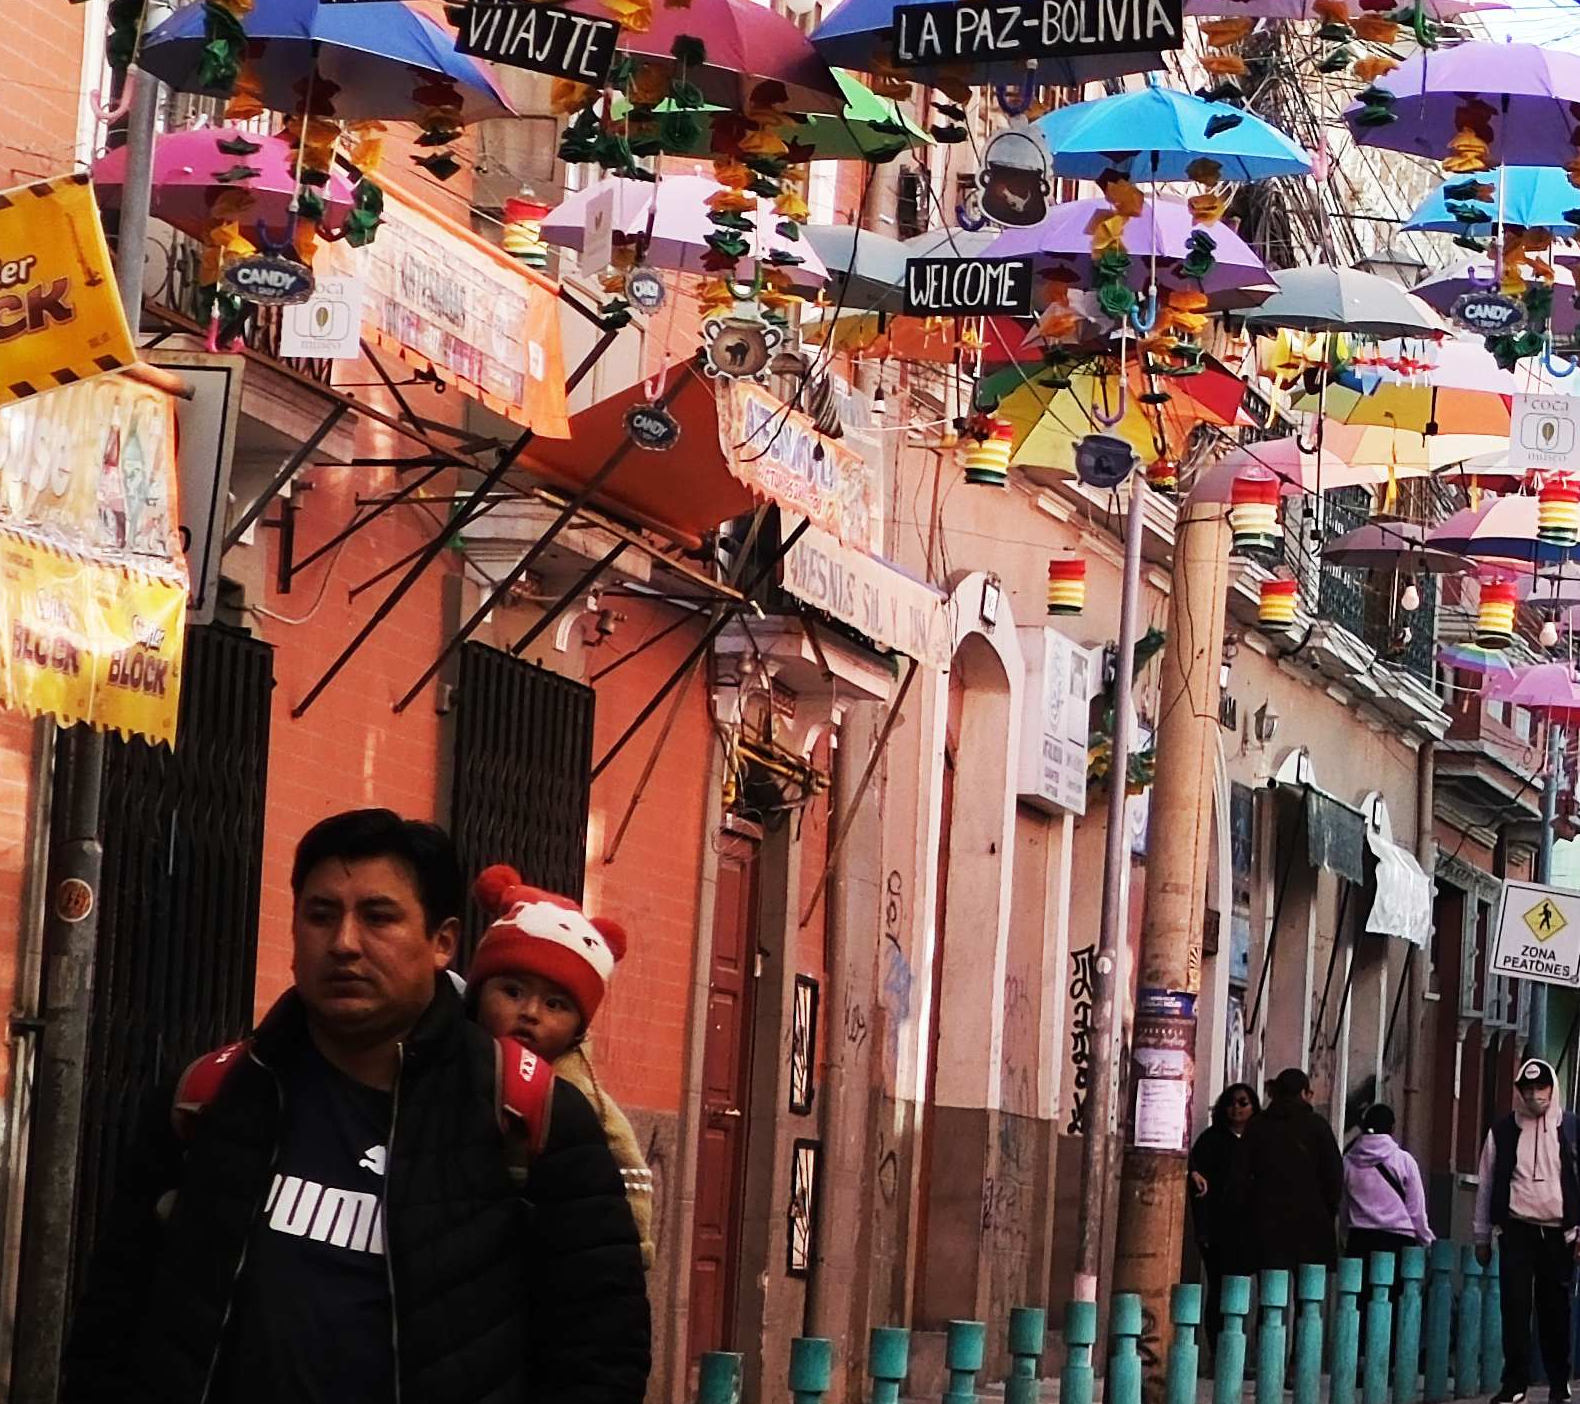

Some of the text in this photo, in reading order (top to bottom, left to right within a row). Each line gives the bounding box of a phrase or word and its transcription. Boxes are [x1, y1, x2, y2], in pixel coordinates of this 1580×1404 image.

[897, 12, 944, 62] LA
[236, 267, 297, 291] CANDY
[908, 261, 1024, 310] WELCOME
[1464, 303, 1514, 324] CANDY
[106, 650, 169, 696] BLOCK
[1520, 945, 1557, 962] ZONA
[1503, 955, 1571, 978] PEATONES
